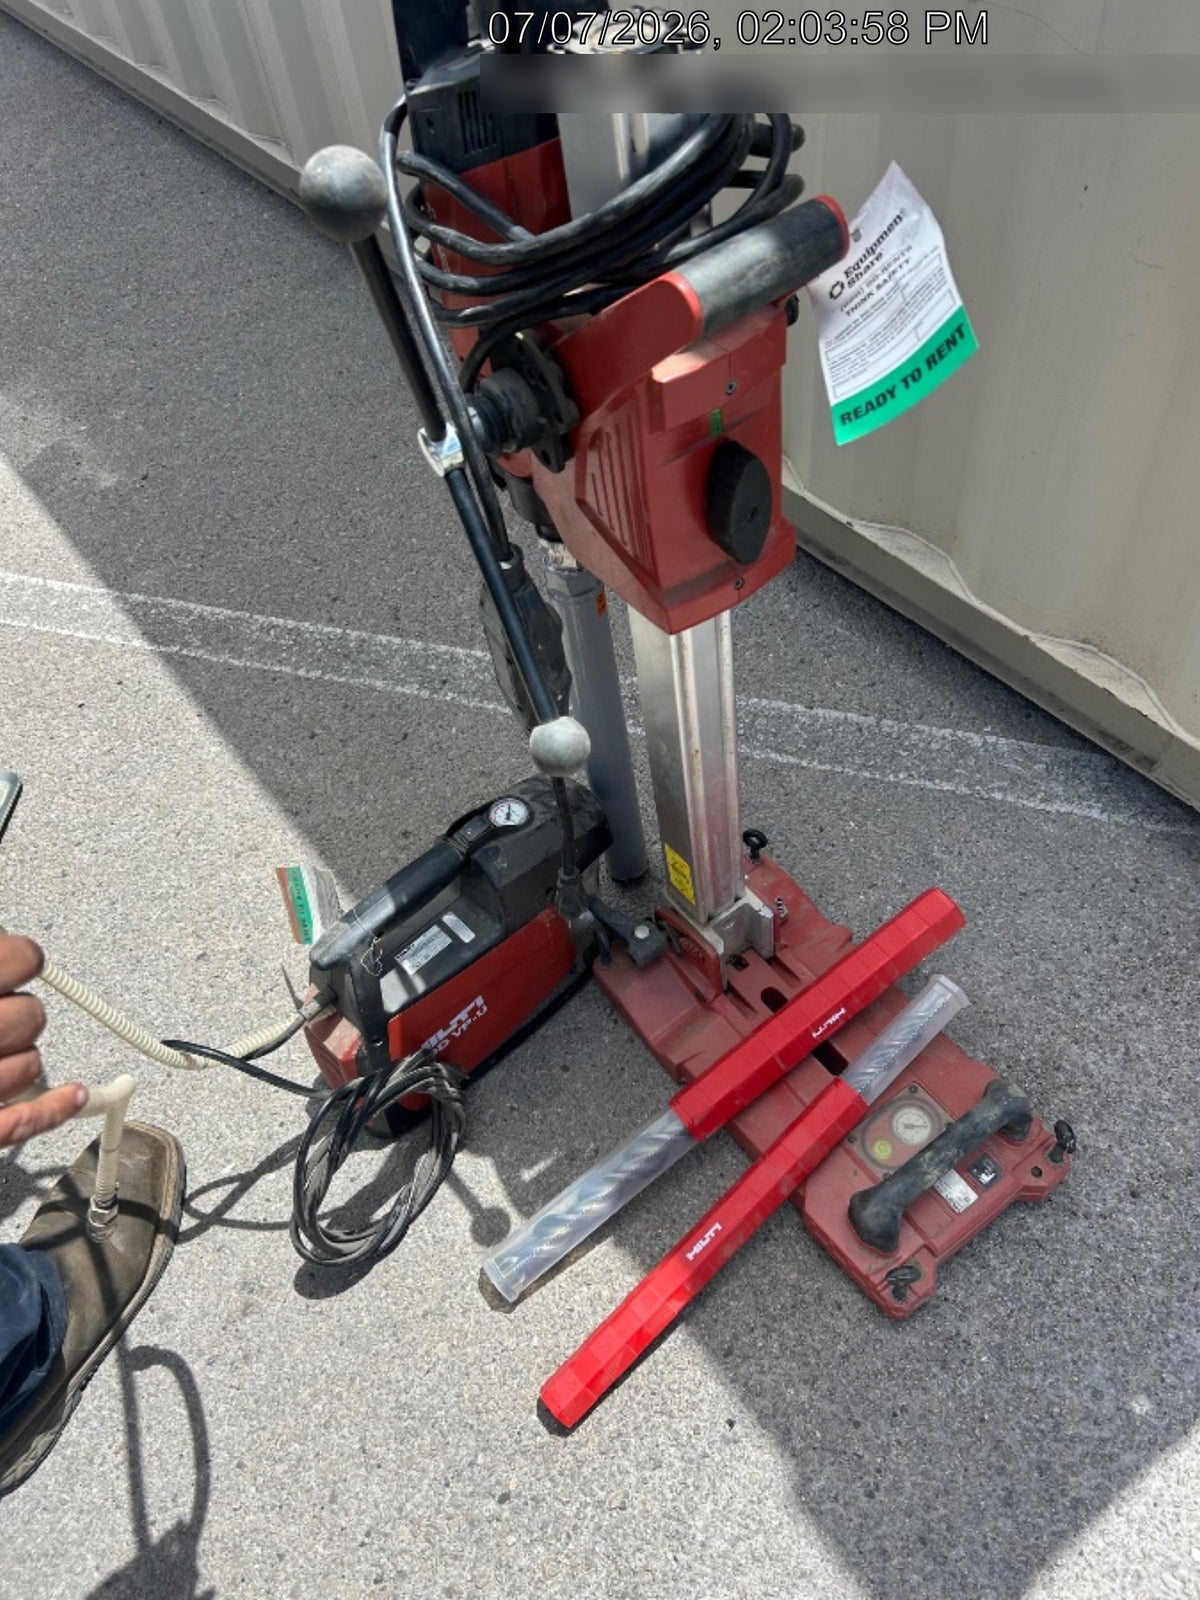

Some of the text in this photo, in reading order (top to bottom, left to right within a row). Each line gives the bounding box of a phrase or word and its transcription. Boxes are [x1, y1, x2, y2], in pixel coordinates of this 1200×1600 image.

[843, 209, 905, 279] Equipmen
[845, 258, 911, 316] THINK SAFETY
[846, 251, 883, 288] Share
[840, 384, 897, 426] READY
[900, 367, 922, 390] TO
[925, 323, 965, 371] RENT
[812, 1007, 846, 1038] HILTI
[686, 1222, 722, 1261] HILTI
